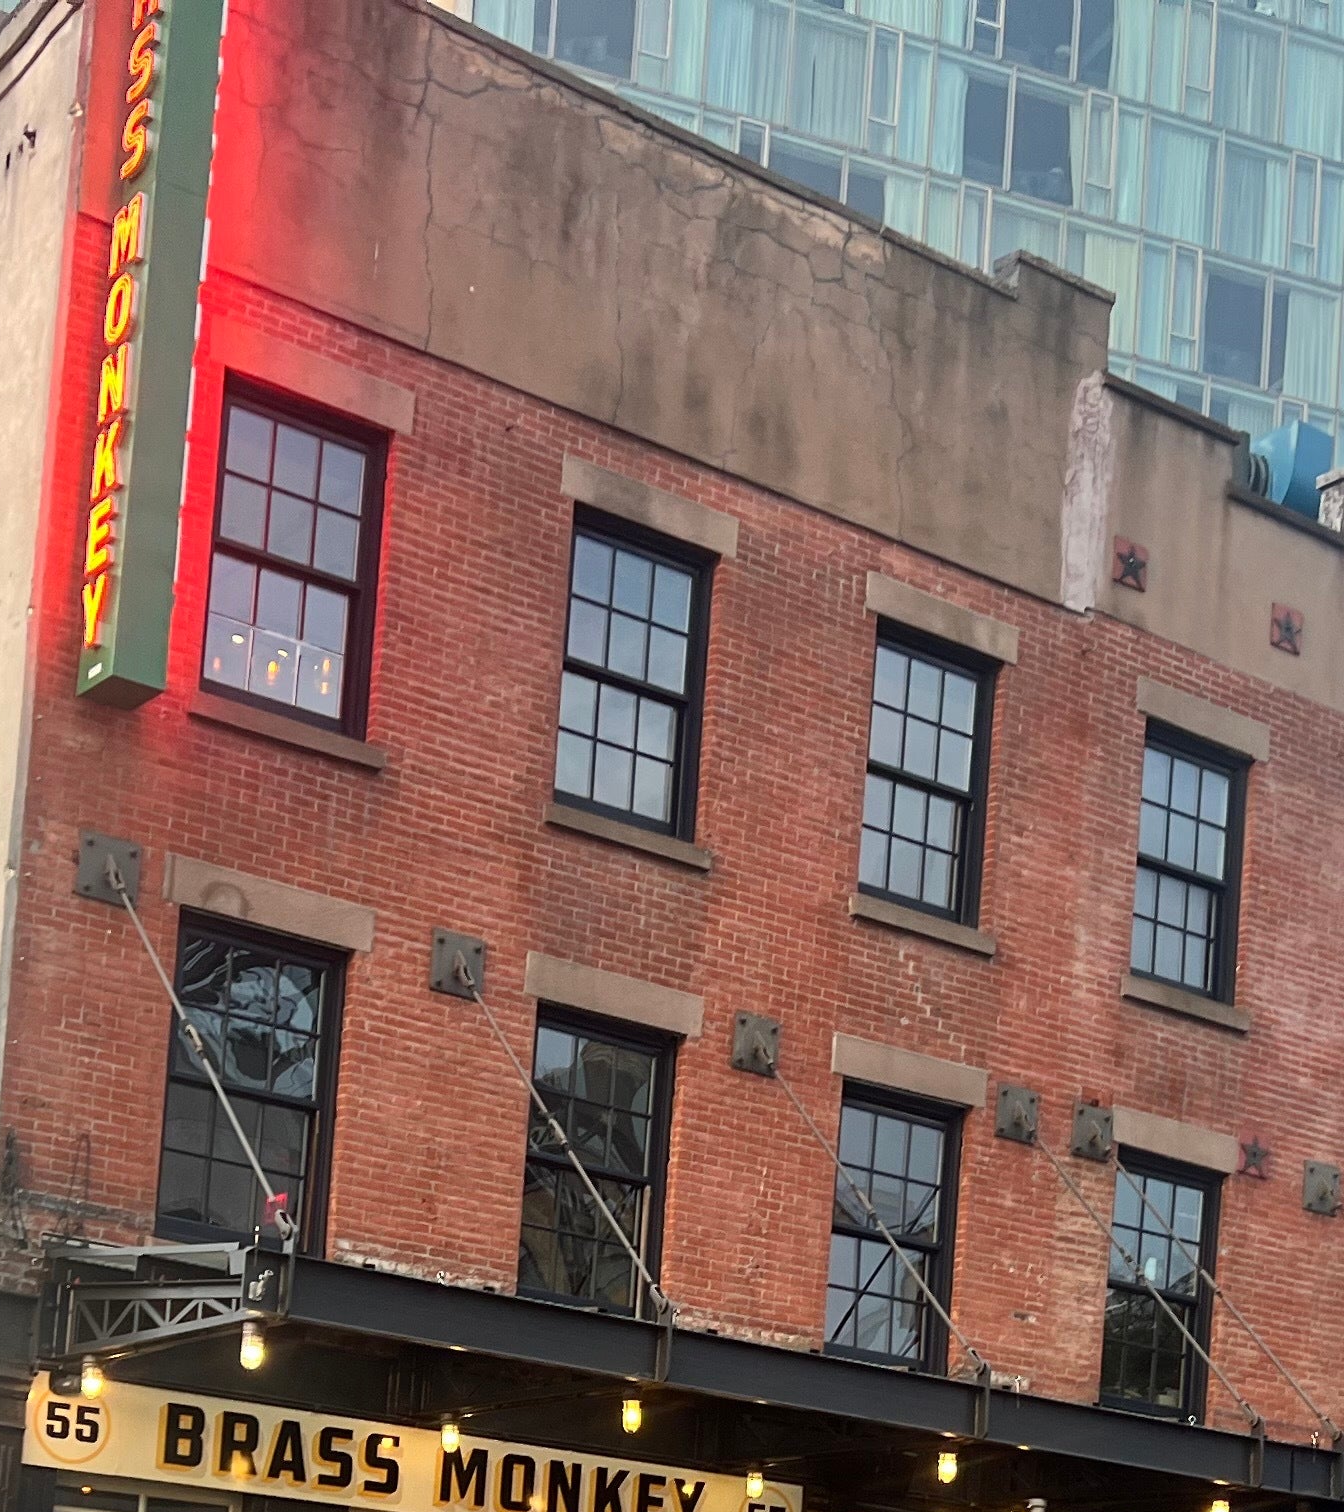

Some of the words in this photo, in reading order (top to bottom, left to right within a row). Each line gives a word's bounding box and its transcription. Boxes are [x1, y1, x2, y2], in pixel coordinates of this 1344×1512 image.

[83, 191, 148, 648] MONKEY
[45, 1401, 101, 1443] 55
[157, 1402, 401, 1499] BRASS
